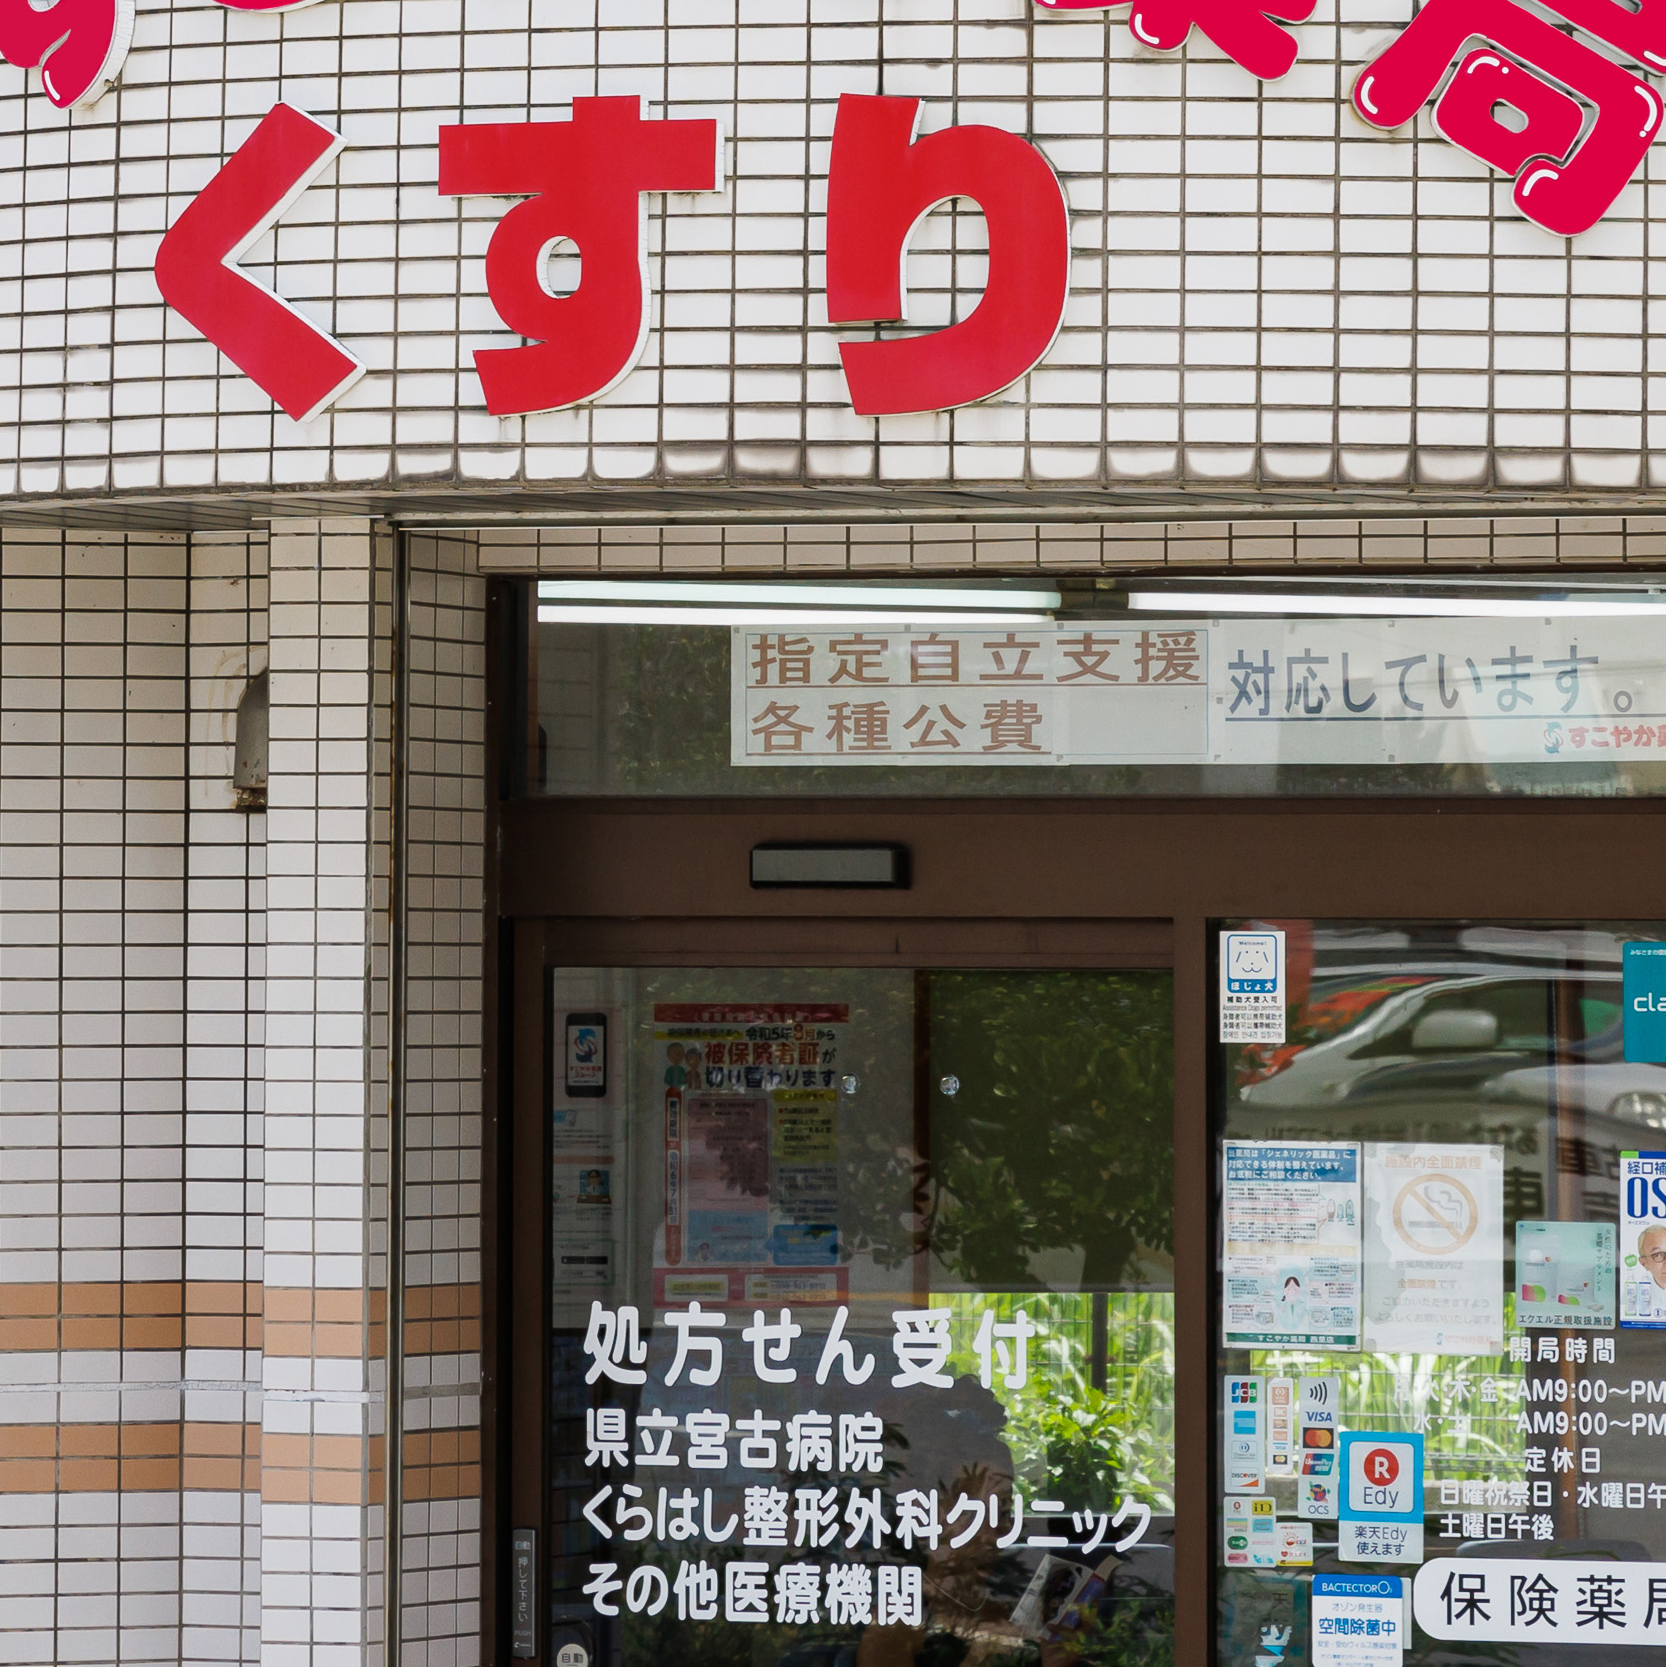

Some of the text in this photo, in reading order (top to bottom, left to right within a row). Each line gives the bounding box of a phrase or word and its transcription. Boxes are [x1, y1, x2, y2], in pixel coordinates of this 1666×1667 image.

[154, 92, 1071, 423] くすり
[750, 631, 1204, 686] 指定自立支援
[1225, 648, 1633, 718] 対応しています。
[750, 699, 1045, 754] 各種公費
[1231, 981, 1274, 991] ほじょ犬
[704, 1041, 837, 1066] 被保険者証が
[704, 1066, 837, 1089] 切り替わります
[1385, 1154, 1482, 1170] 施設内全面禁煙
[1518, 1315, 1613, 1327] エクエル正規取扱施設
[583, 1301, 1035, 1390] 処方せん受付
[1509, 1337, 1616, 1364] 開局時間
[1305, 1411, 1333, 1422] VISA
[584, 1408, 884, 1472] 県立宮古病院
[1374, 1456, 1391, 1479] R
[1524, 1447, 1601, 1474] 定休日
[1254, 1502, 1272, 1512] iD
[1363, 1486, 1399, 1509] Edy
[583, 1483, 1153, 1554] くらはし整形外科クリニック
[1308, 1505, 1330, 1515] OCS
[1355, 1525, 1408, 1543] 楽天Edy
[1439, 1513, 1555, 1541] 土曜日午後
[1356, 1542, 1405, 1556] 使えます
[518, 1556, 529, 1622] 押して下さい
[583, 1560, 924, 1626] その他医療機関
[1332, 1603, 1383, 1613] オゾン発生器
[1318, 1617, 1396, 1637] 空間除菌中
